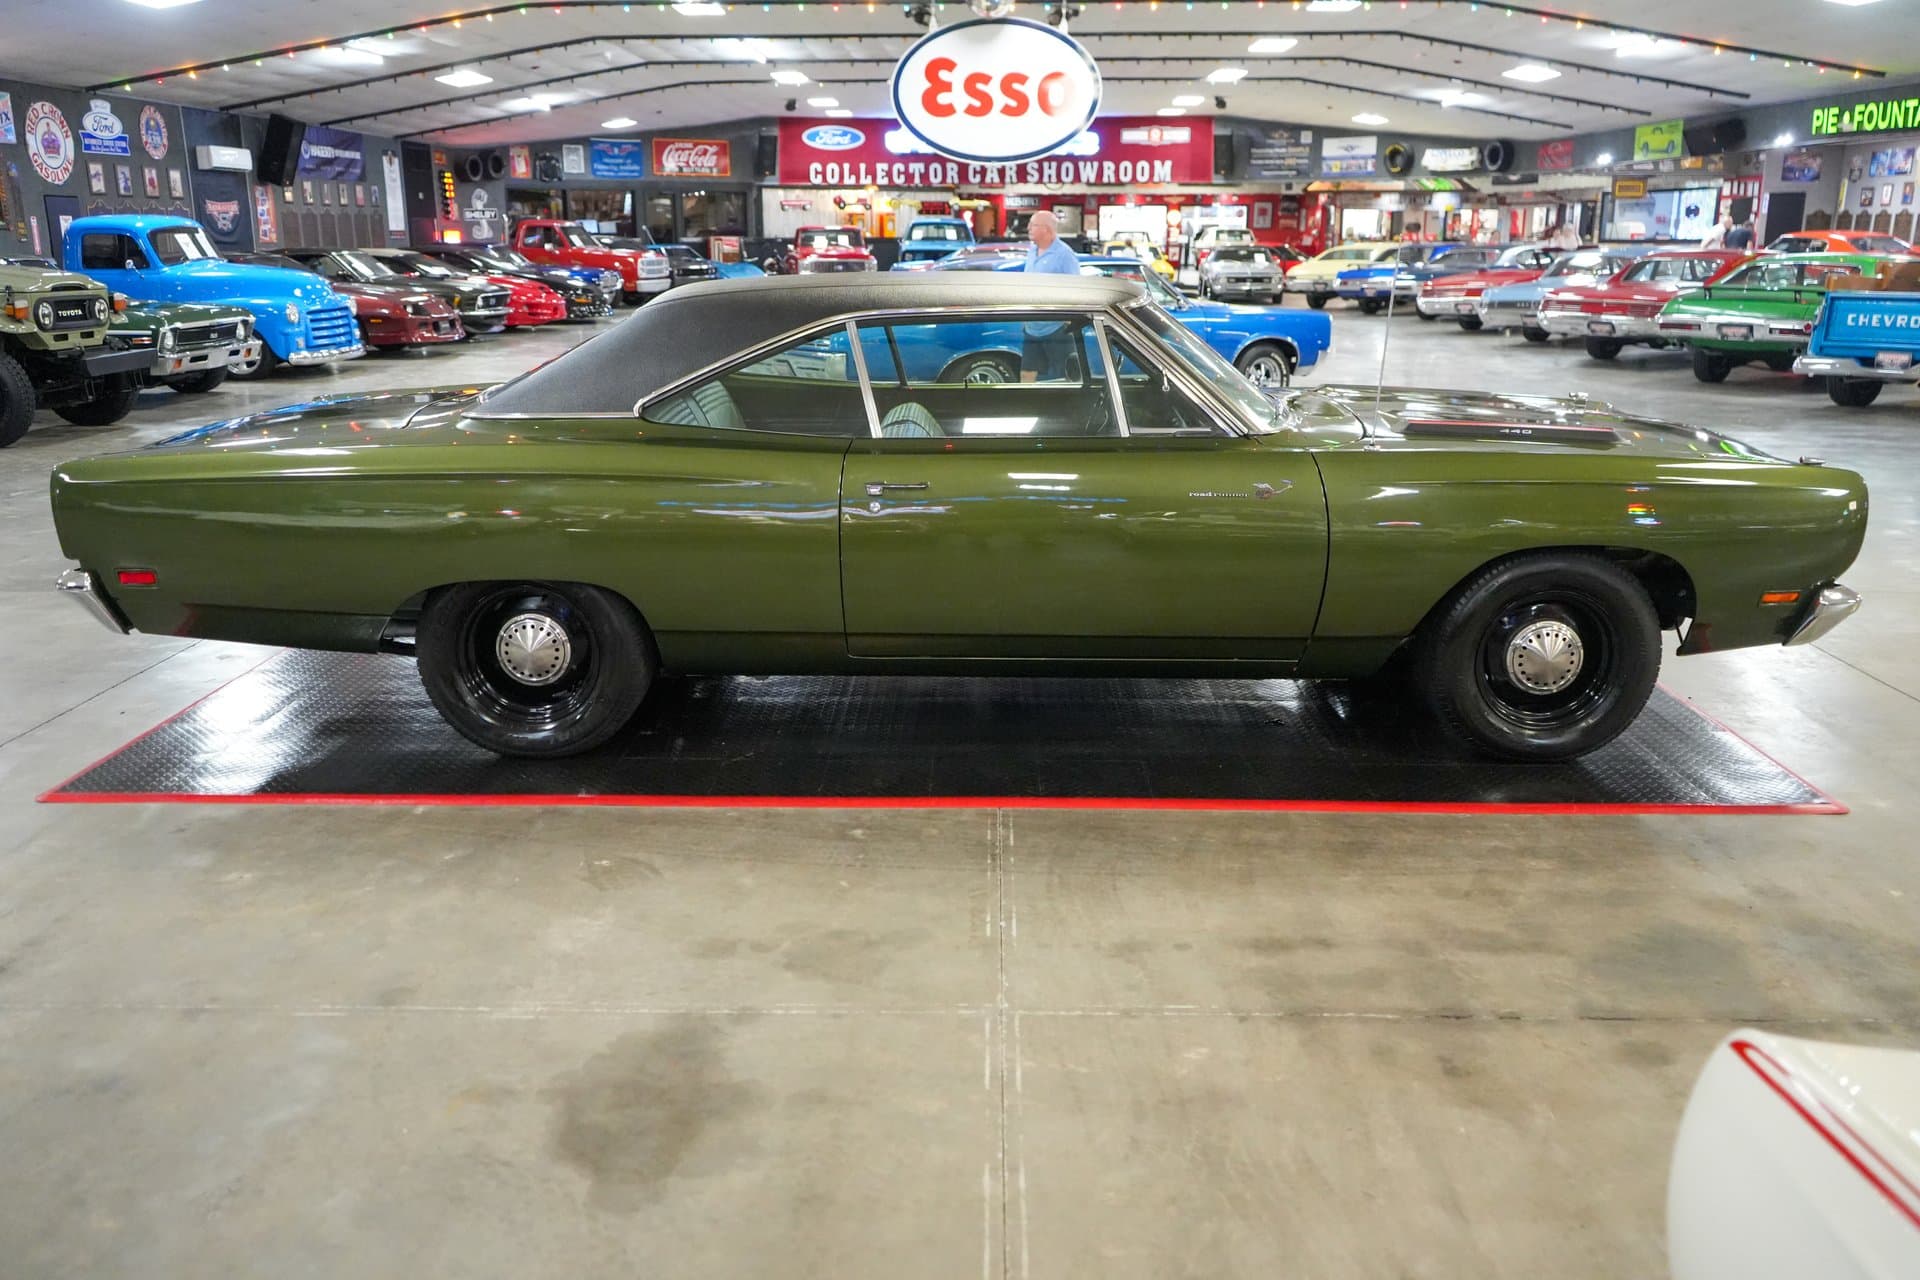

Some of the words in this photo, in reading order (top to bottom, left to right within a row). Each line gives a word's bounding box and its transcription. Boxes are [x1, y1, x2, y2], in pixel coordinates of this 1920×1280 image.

[26, 106, 40, 135] RED
[41, 103, 71, 139] CROWN
[92, 115, 115, 134] Ford
[1812, 106, 1840, 135] PIE
[815, 128, 852, 145] Ford
[662, 143, 720, 168] Coca-Cola
[808, 161, 959, 185] COLLECTOR
[967, 161, 1018, 184] CAR
[1026, 159, 1173, 184] SHOWROOM
[464, 210, 496, 218] SHELBY
[58, 309, 83, 317] TOYOTA
